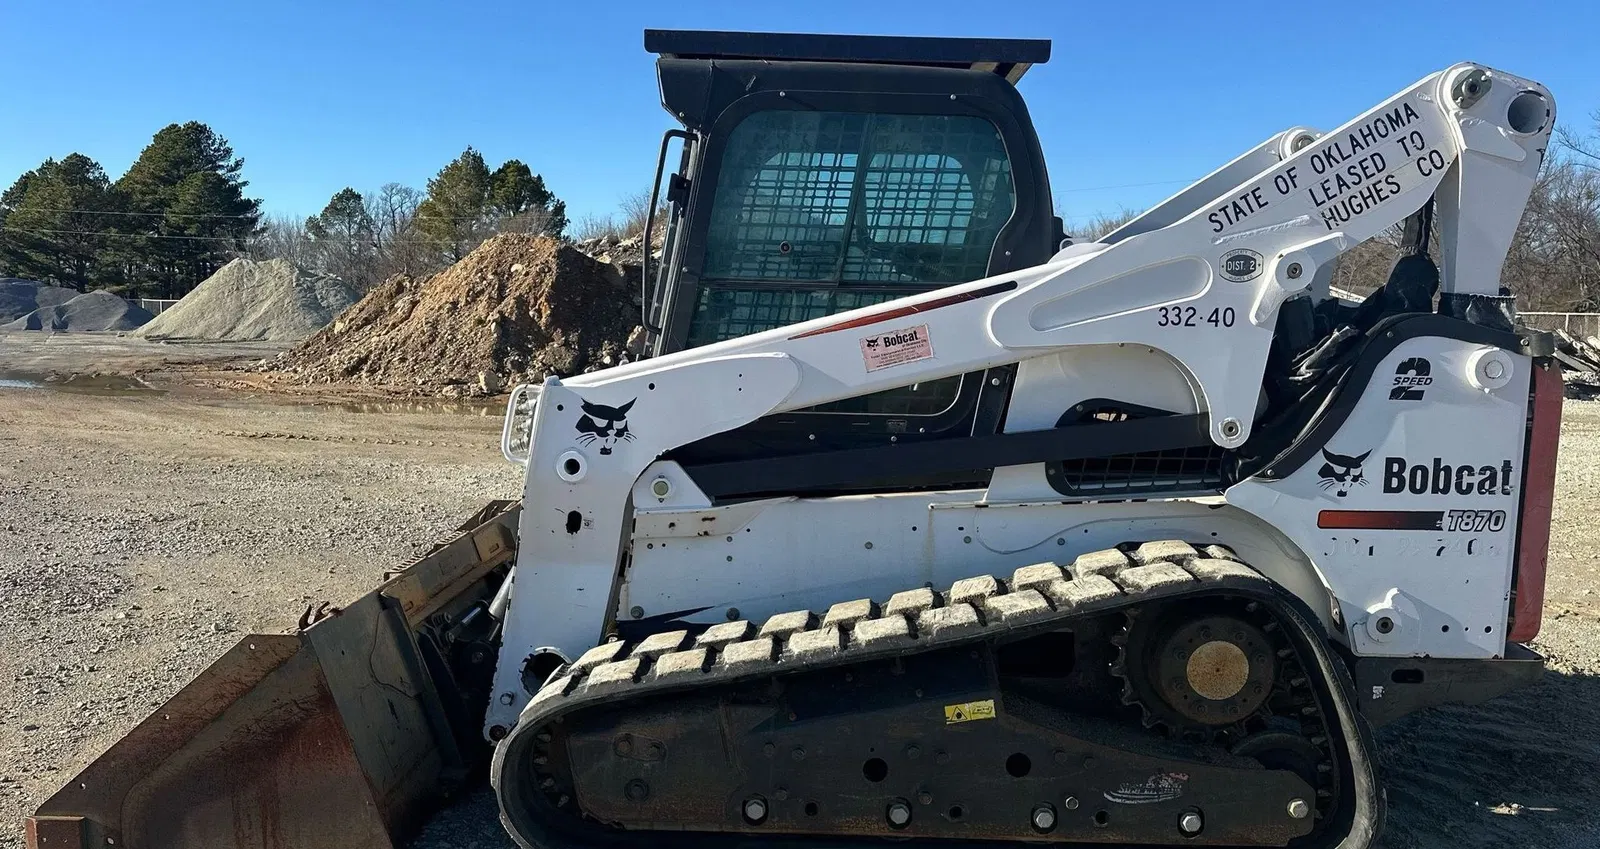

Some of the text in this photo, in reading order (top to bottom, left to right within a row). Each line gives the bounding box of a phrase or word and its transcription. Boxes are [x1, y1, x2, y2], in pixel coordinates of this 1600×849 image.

[1208, 102, 1420, 233] STATE OF OKLAHOMA
[1308, 130, 1426, 208] LEASED TO
[1320, 174, 1401, 231] HUGHES
[1227, 260, 1255, 271] DIST. 2
[883, 330, 919, 348] Bobcat
[1389, 357, 1431, 400] 2
[1393, 376, 1433, 386] SPEED
[1383, 456, 1513, 496] Bobcat
[1447, 510, 1506, 532] T870
